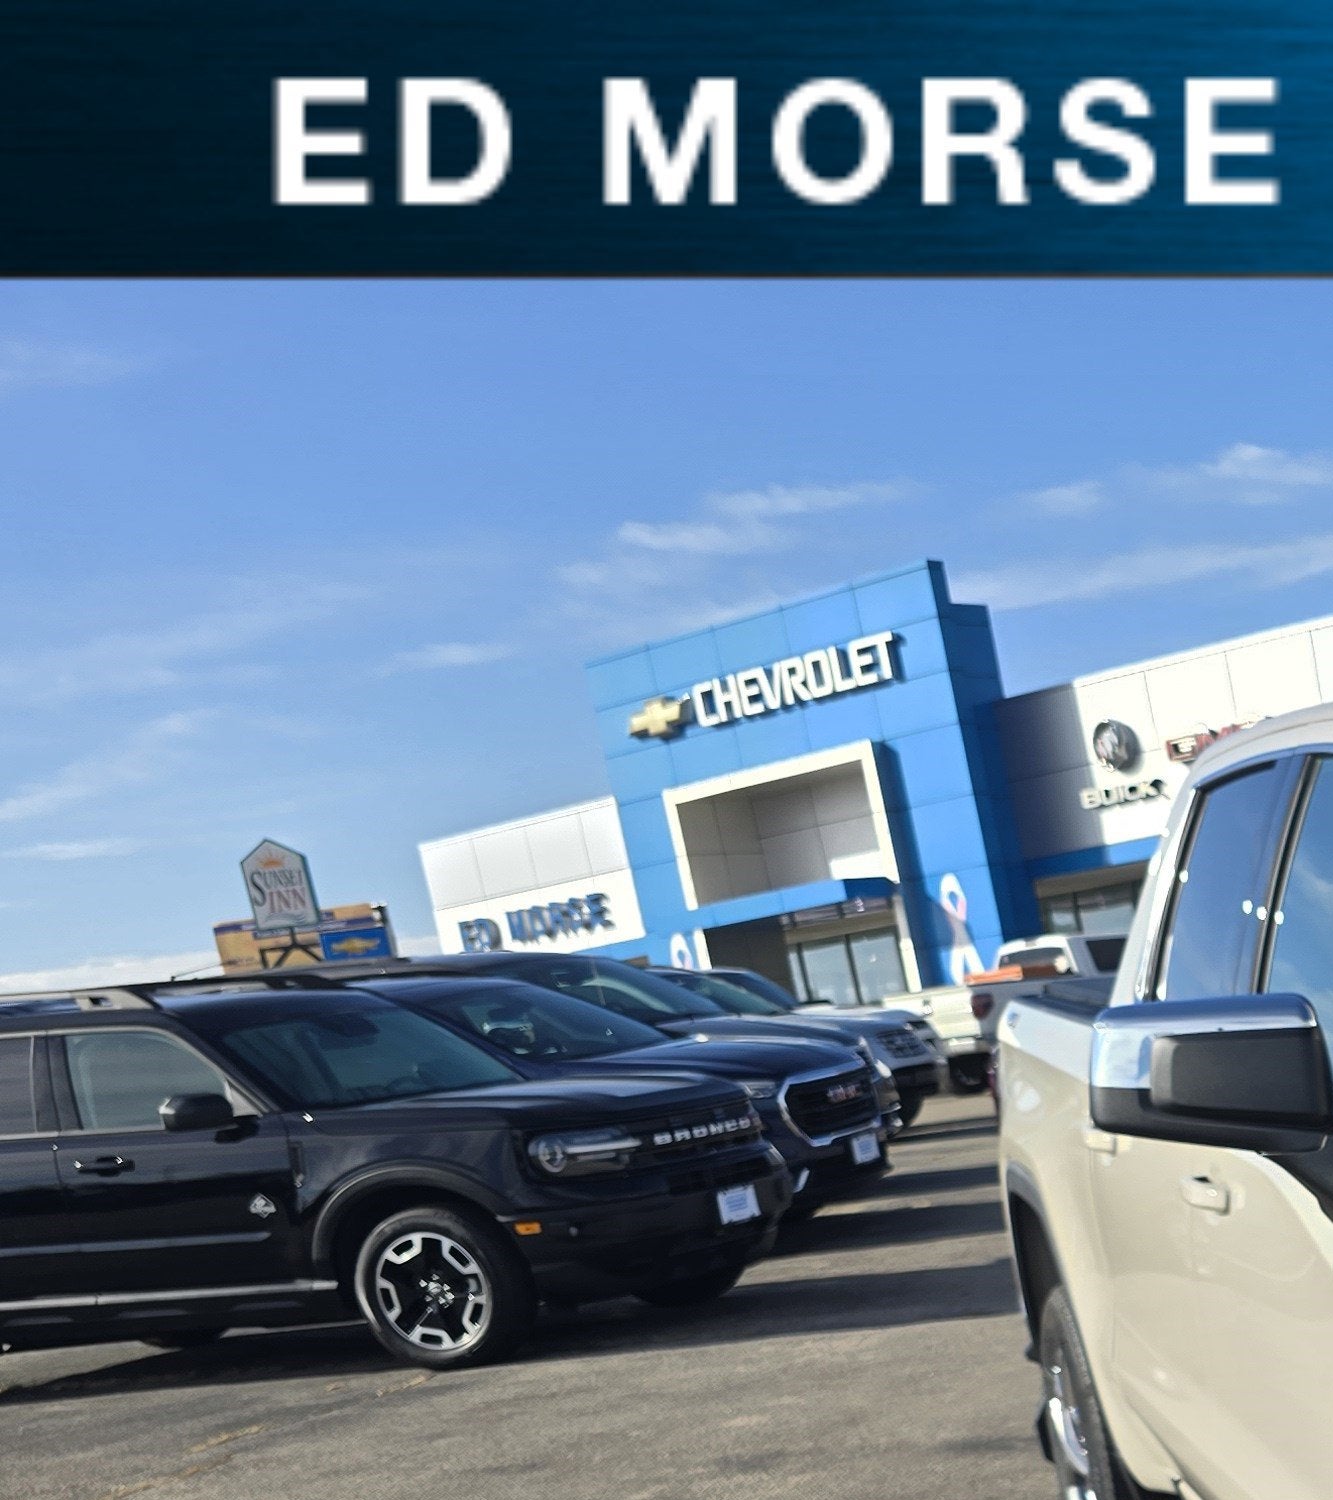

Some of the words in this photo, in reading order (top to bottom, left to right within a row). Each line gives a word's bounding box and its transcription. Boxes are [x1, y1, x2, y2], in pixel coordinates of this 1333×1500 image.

[691, 630, 894, 728] CHEVROLET
[1079, 779, 1164, 810] BUICK
[268, 886, 307, 914] INN
[458, 918, 504, 952] ED
[653, 1116, 752, 1146] BRONCO
